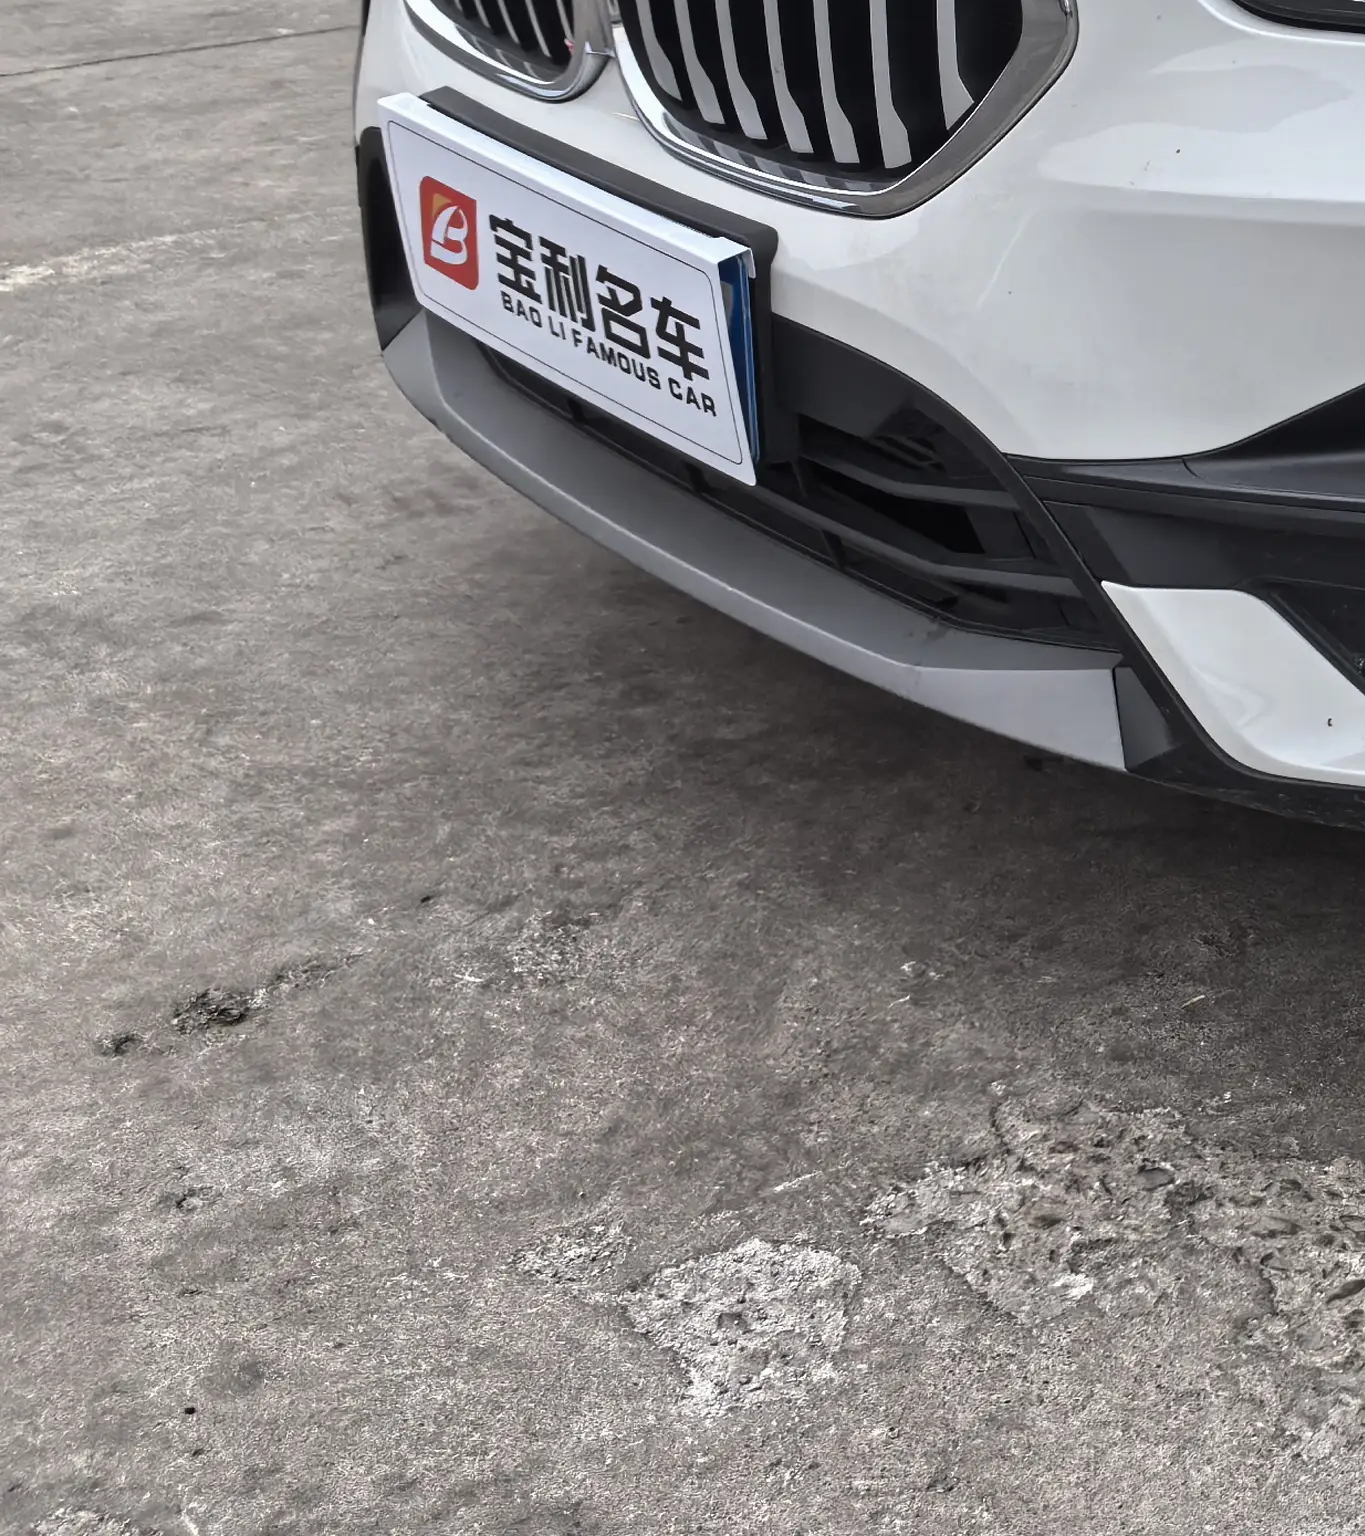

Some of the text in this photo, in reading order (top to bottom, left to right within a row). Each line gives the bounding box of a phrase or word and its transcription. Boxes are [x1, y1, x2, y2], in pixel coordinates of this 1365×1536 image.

[489, 214, 710, 381] 宝利名车
[501, 290, 717, 417] BAO LI FAMOUS CAR
